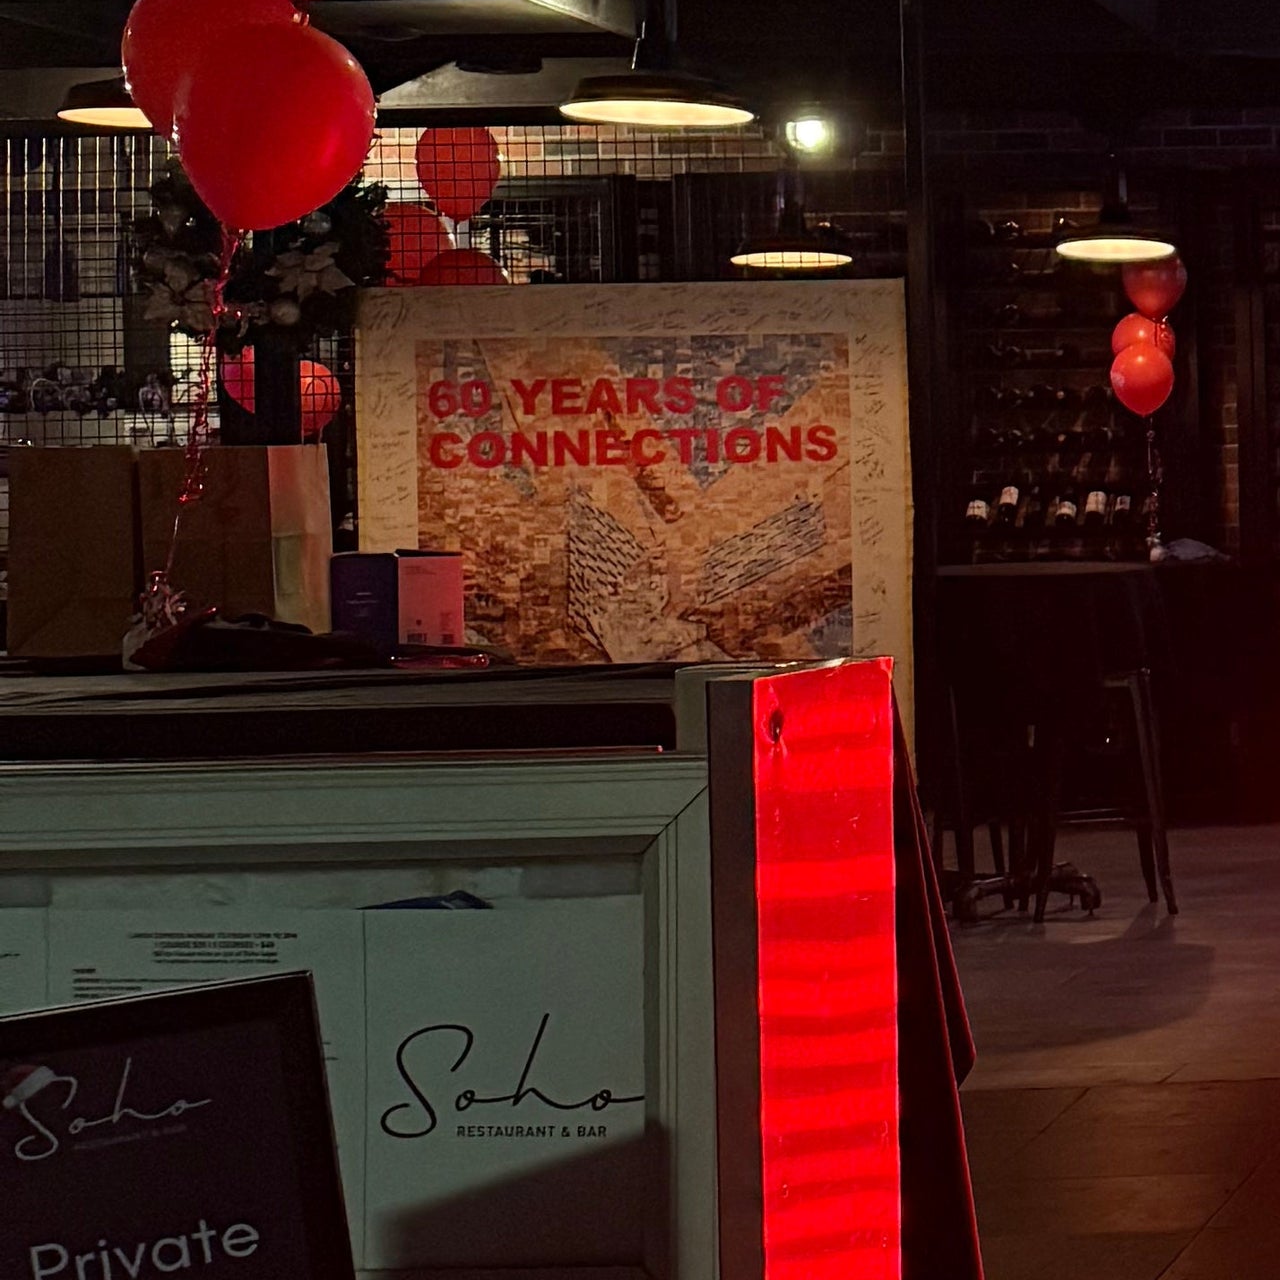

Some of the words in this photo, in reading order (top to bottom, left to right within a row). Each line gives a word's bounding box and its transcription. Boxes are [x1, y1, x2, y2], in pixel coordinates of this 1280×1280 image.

[427, 379, 493, 420] 60
[510, 376, 697, 416] YEARS
[715, 374, 788, 414] OF
[429, 425, 839, 469] CONNECTIONS
[380, 1013, 645, 1139] Soho
[14, 1056, 213, 1161] Soho
[456, 1125, 556, 1138] RESTAURANT
[561, 1125, 571, 1138] &
[576, 1125, 608, 1138] BAR
